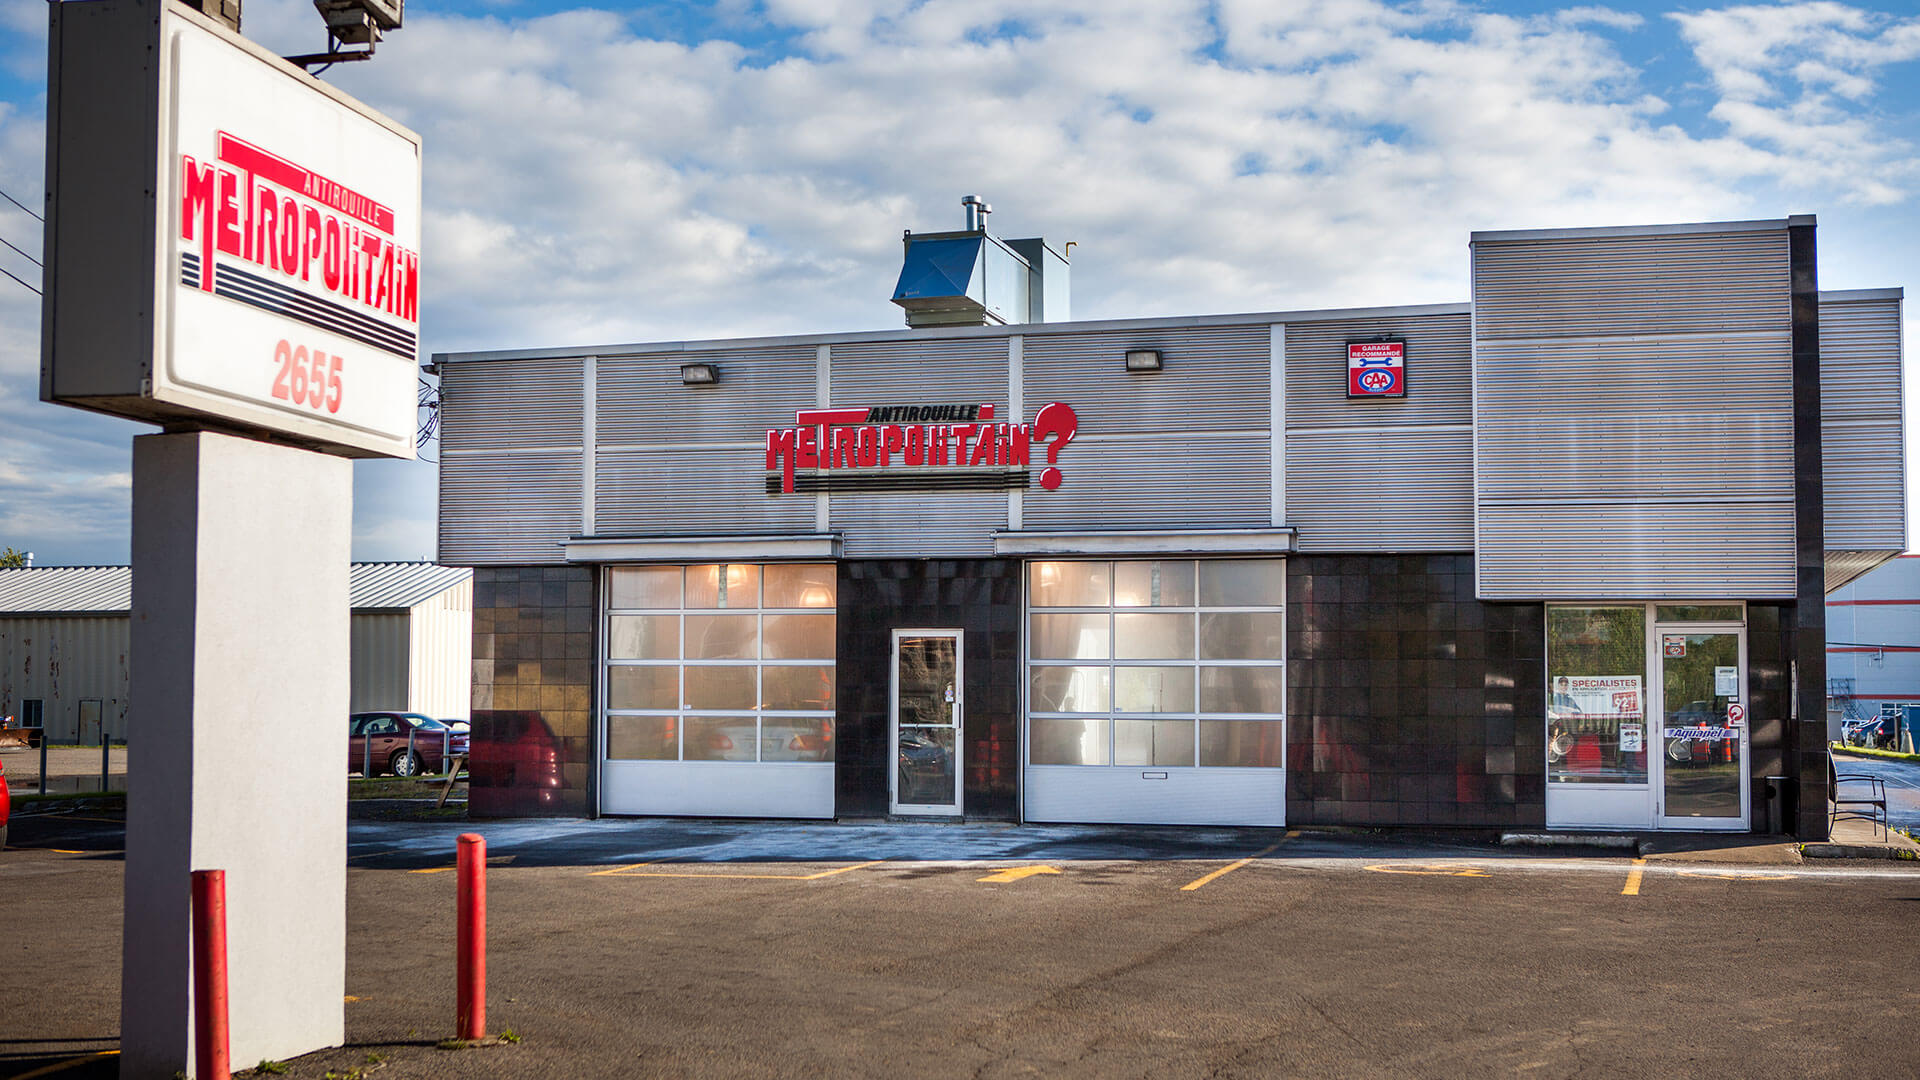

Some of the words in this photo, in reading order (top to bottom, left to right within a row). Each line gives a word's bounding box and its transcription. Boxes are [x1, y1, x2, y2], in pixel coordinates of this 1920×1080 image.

[303, 170, 381, 226] ANTIROUILLE
[271, 338, 344, 414] 2655
[1364, 372, 1389, 388] CAA
[865, 403, 979, 423] ANTIROUILLE
[1033, 401, 1078, 491] ?
[1674, 727, 1723, 741] Aquapel
